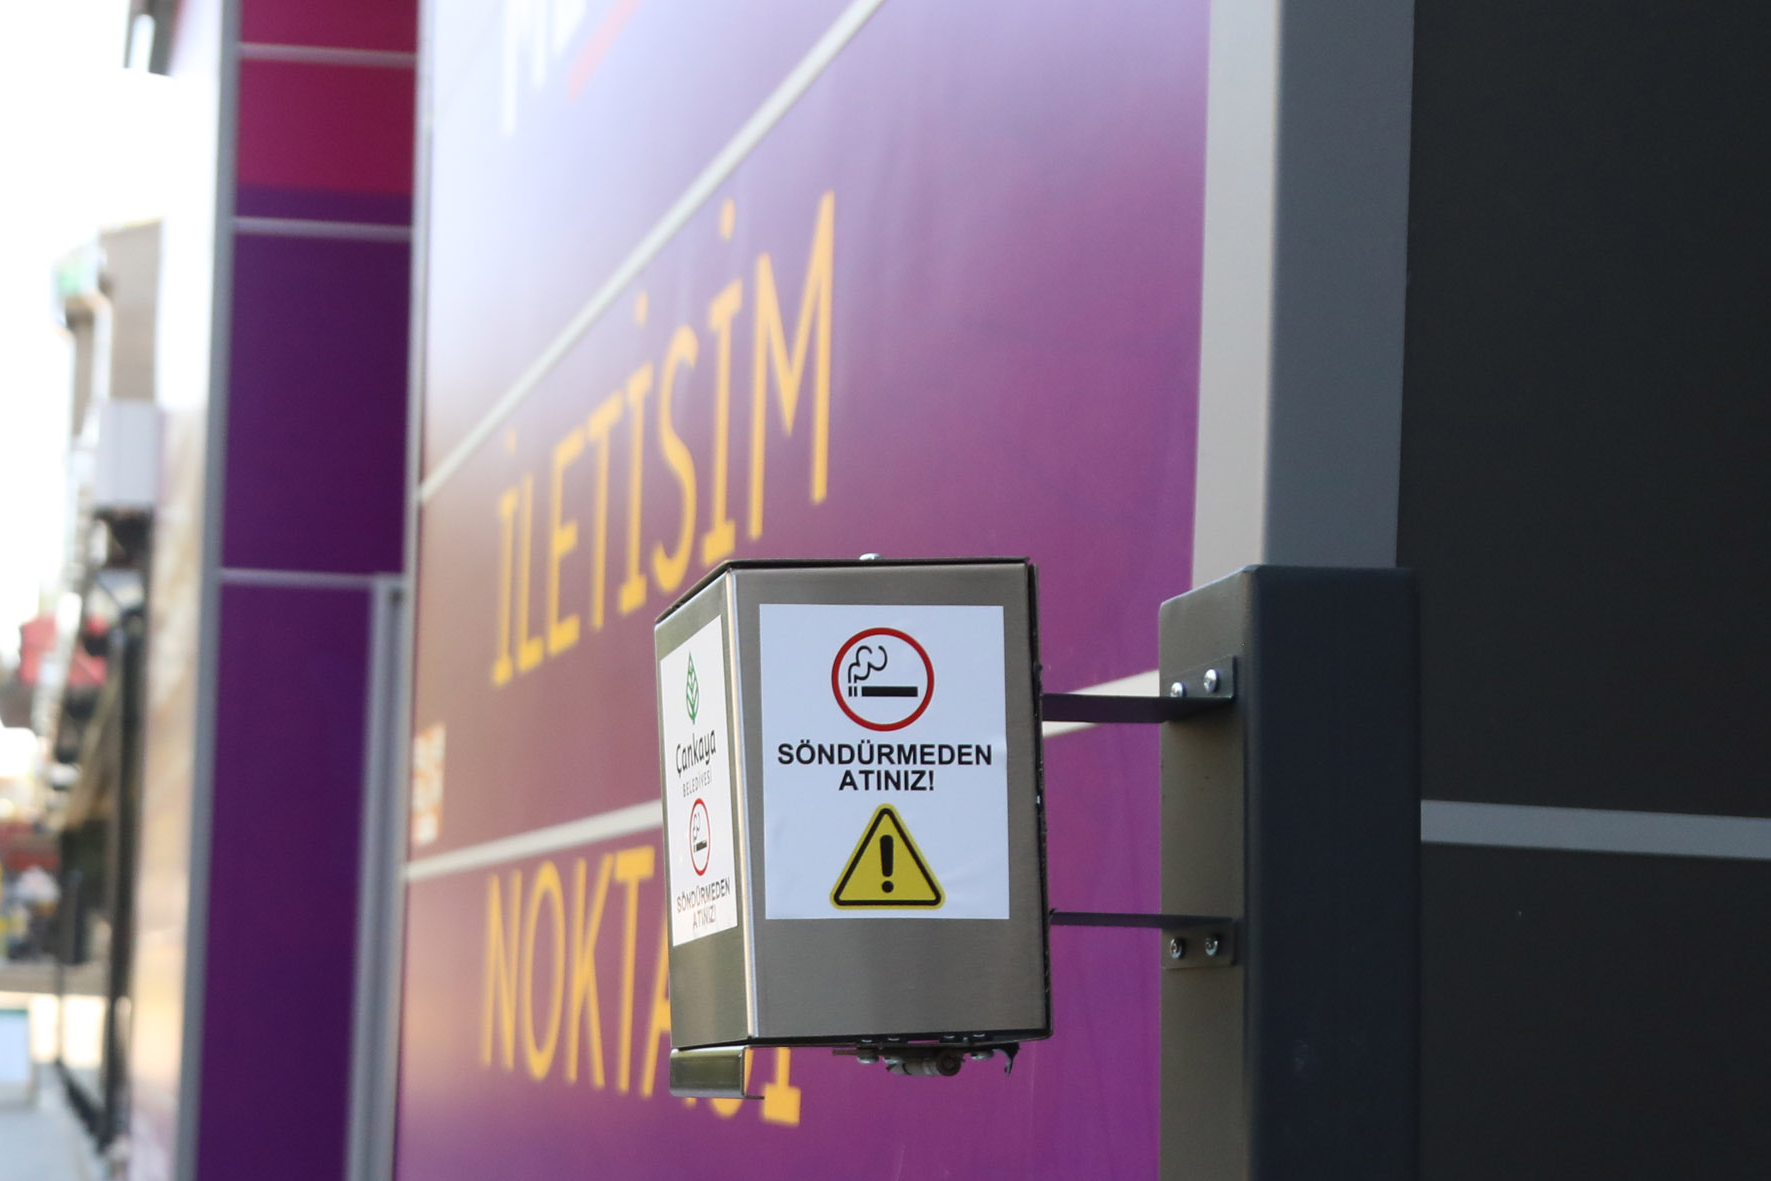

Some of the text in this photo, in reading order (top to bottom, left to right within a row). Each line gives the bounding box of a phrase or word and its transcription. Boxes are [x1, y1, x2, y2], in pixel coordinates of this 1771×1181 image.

[677, 729, 717, 779] Çankaya
[777, 739, 993, 766] SÖNDÜRMEDEN
[682, 767, 713, 798] BELEDİYESİ
[838, 769, 935, 791] ATINIZ!
[677, 876, 730, 913] SÖNDÜRMEDEN
